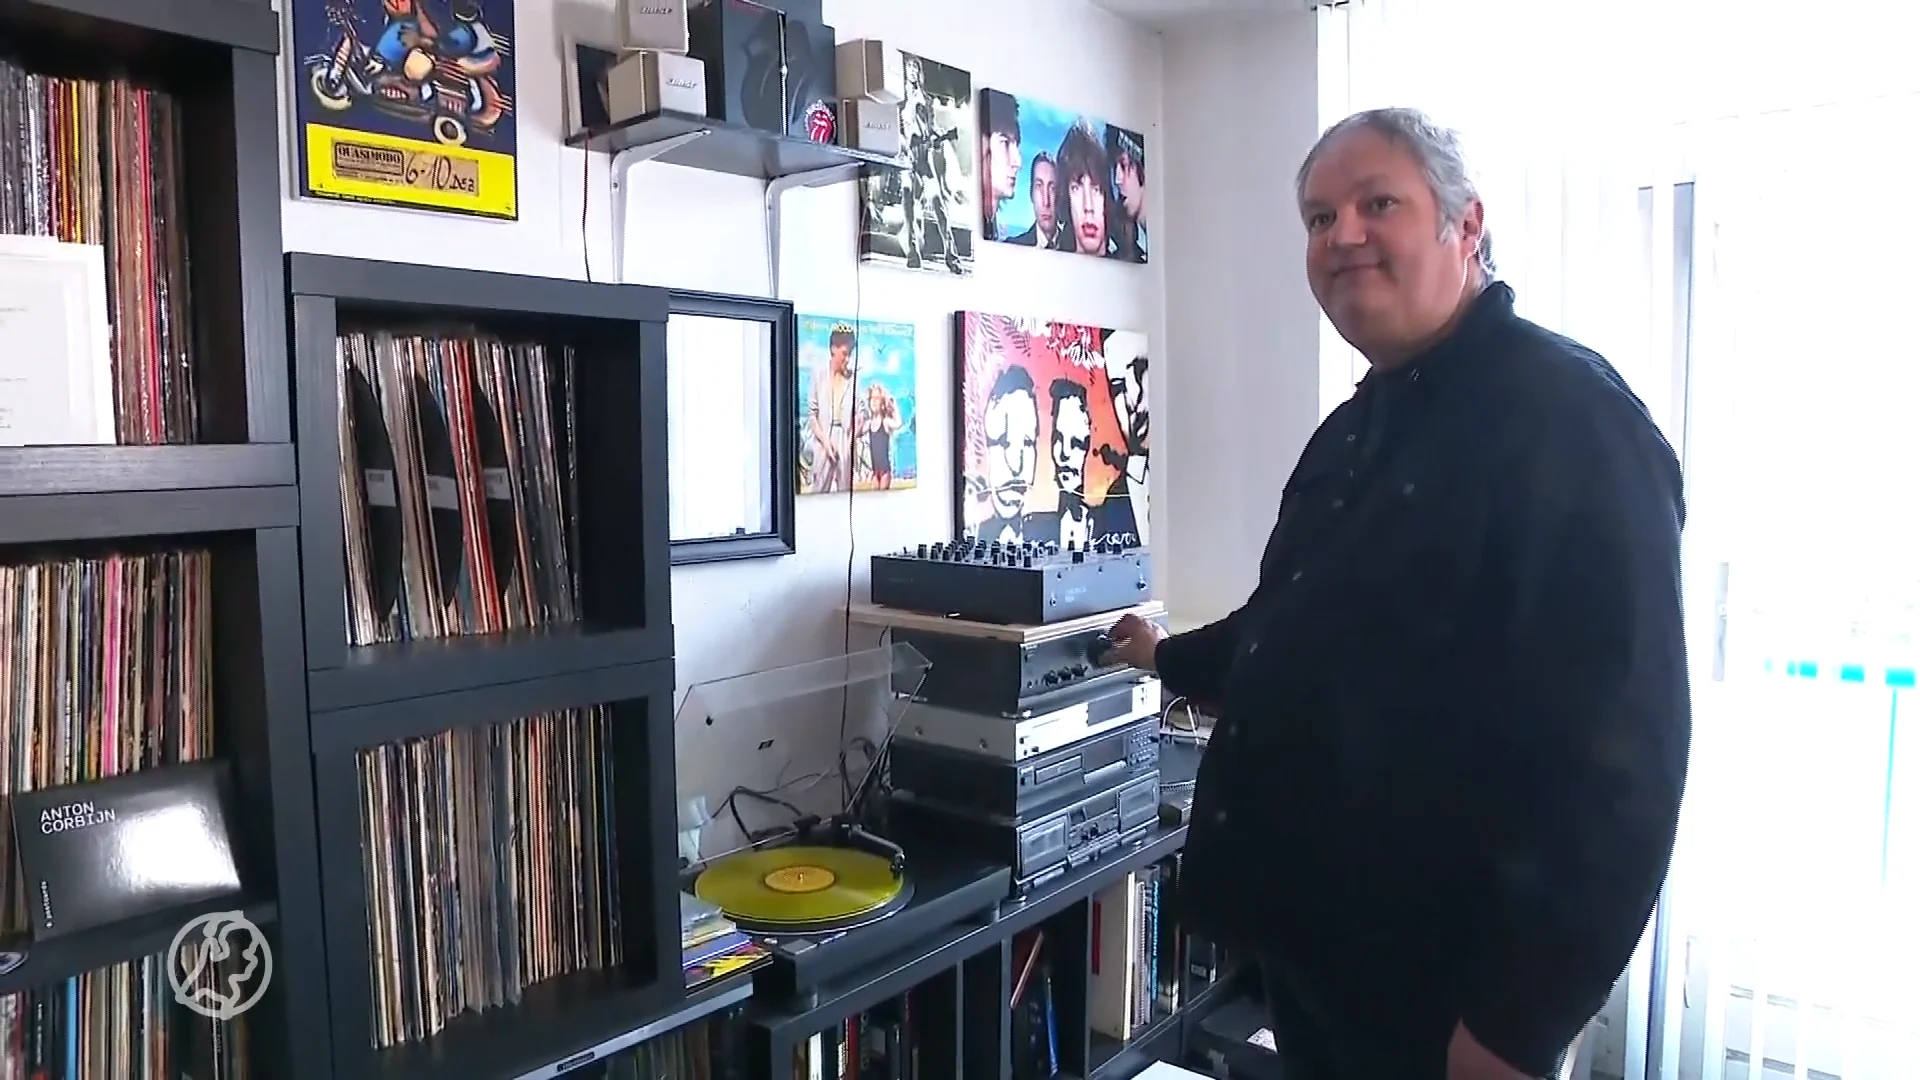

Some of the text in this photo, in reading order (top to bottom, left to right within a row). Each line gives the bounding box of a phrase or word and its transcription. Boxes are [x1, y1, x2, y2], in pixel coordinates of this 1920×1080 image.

[337, 145, 401, 164] QUASIMODO
[41, 801, 94, 822] ANTON
[41, 808, 116, 834] CORBIJN
